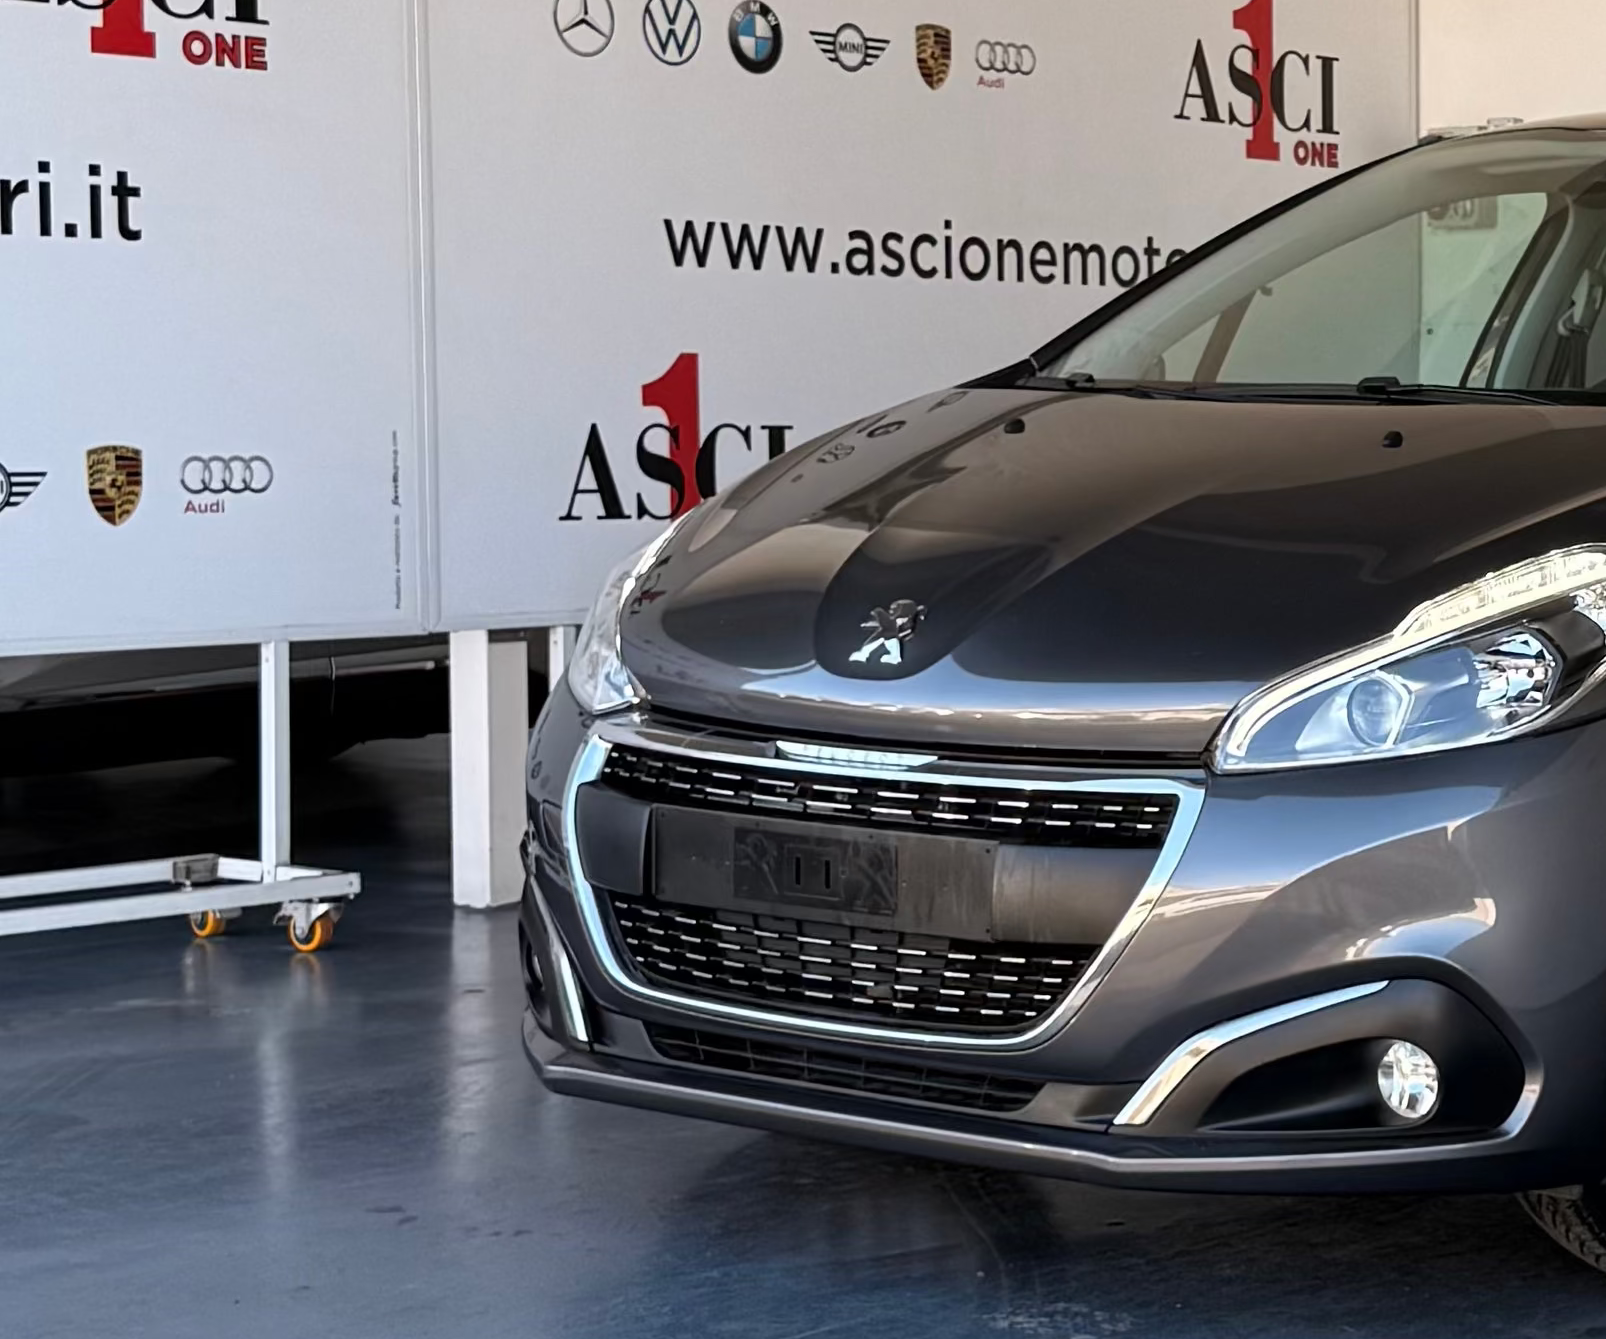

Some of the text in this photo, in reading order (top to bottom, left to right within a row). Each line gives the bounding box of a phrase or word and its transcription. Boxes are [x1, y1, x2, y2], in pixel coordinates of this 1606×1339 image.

[181, 29, 268, 71] ONE
[838, 41, 864, 55] MINI
[976, 75, 1006, 89] Audi
[1173, 38, 1341, 135] ASCI
[1292, 139, 1340, 169] ONE
[0, 160, 143, 242] ri.it
[183, 498, 226, 514] Audi
